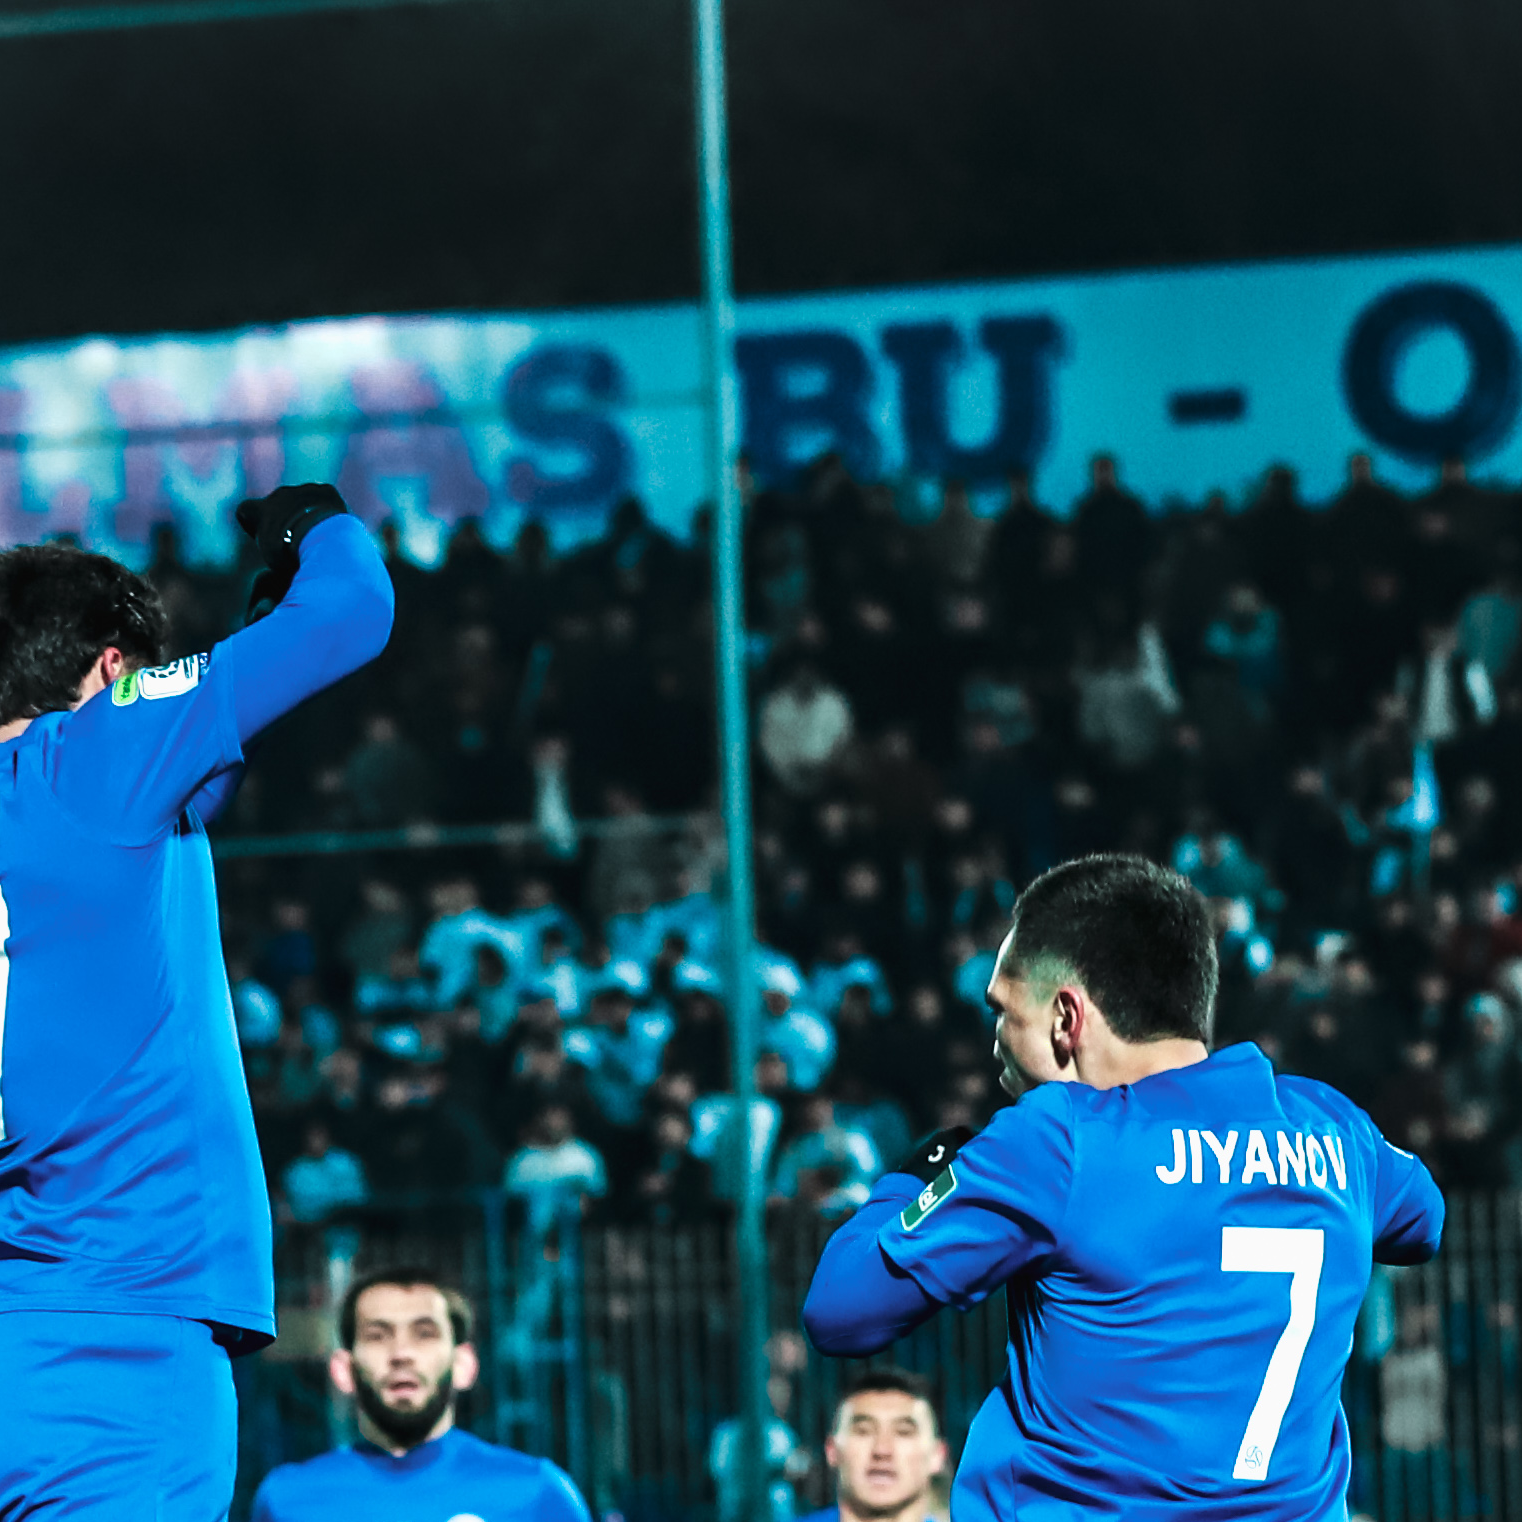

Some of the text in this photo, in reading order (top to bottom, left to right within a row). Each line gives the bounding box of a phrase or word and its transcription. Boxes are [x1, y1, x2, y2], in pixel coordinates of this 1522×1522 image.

[732, 313, 1067, 488] BU
[1156, 1128, 1348, 1191] JIYANOV
[1220, 1226, 1324, 1481] 7
